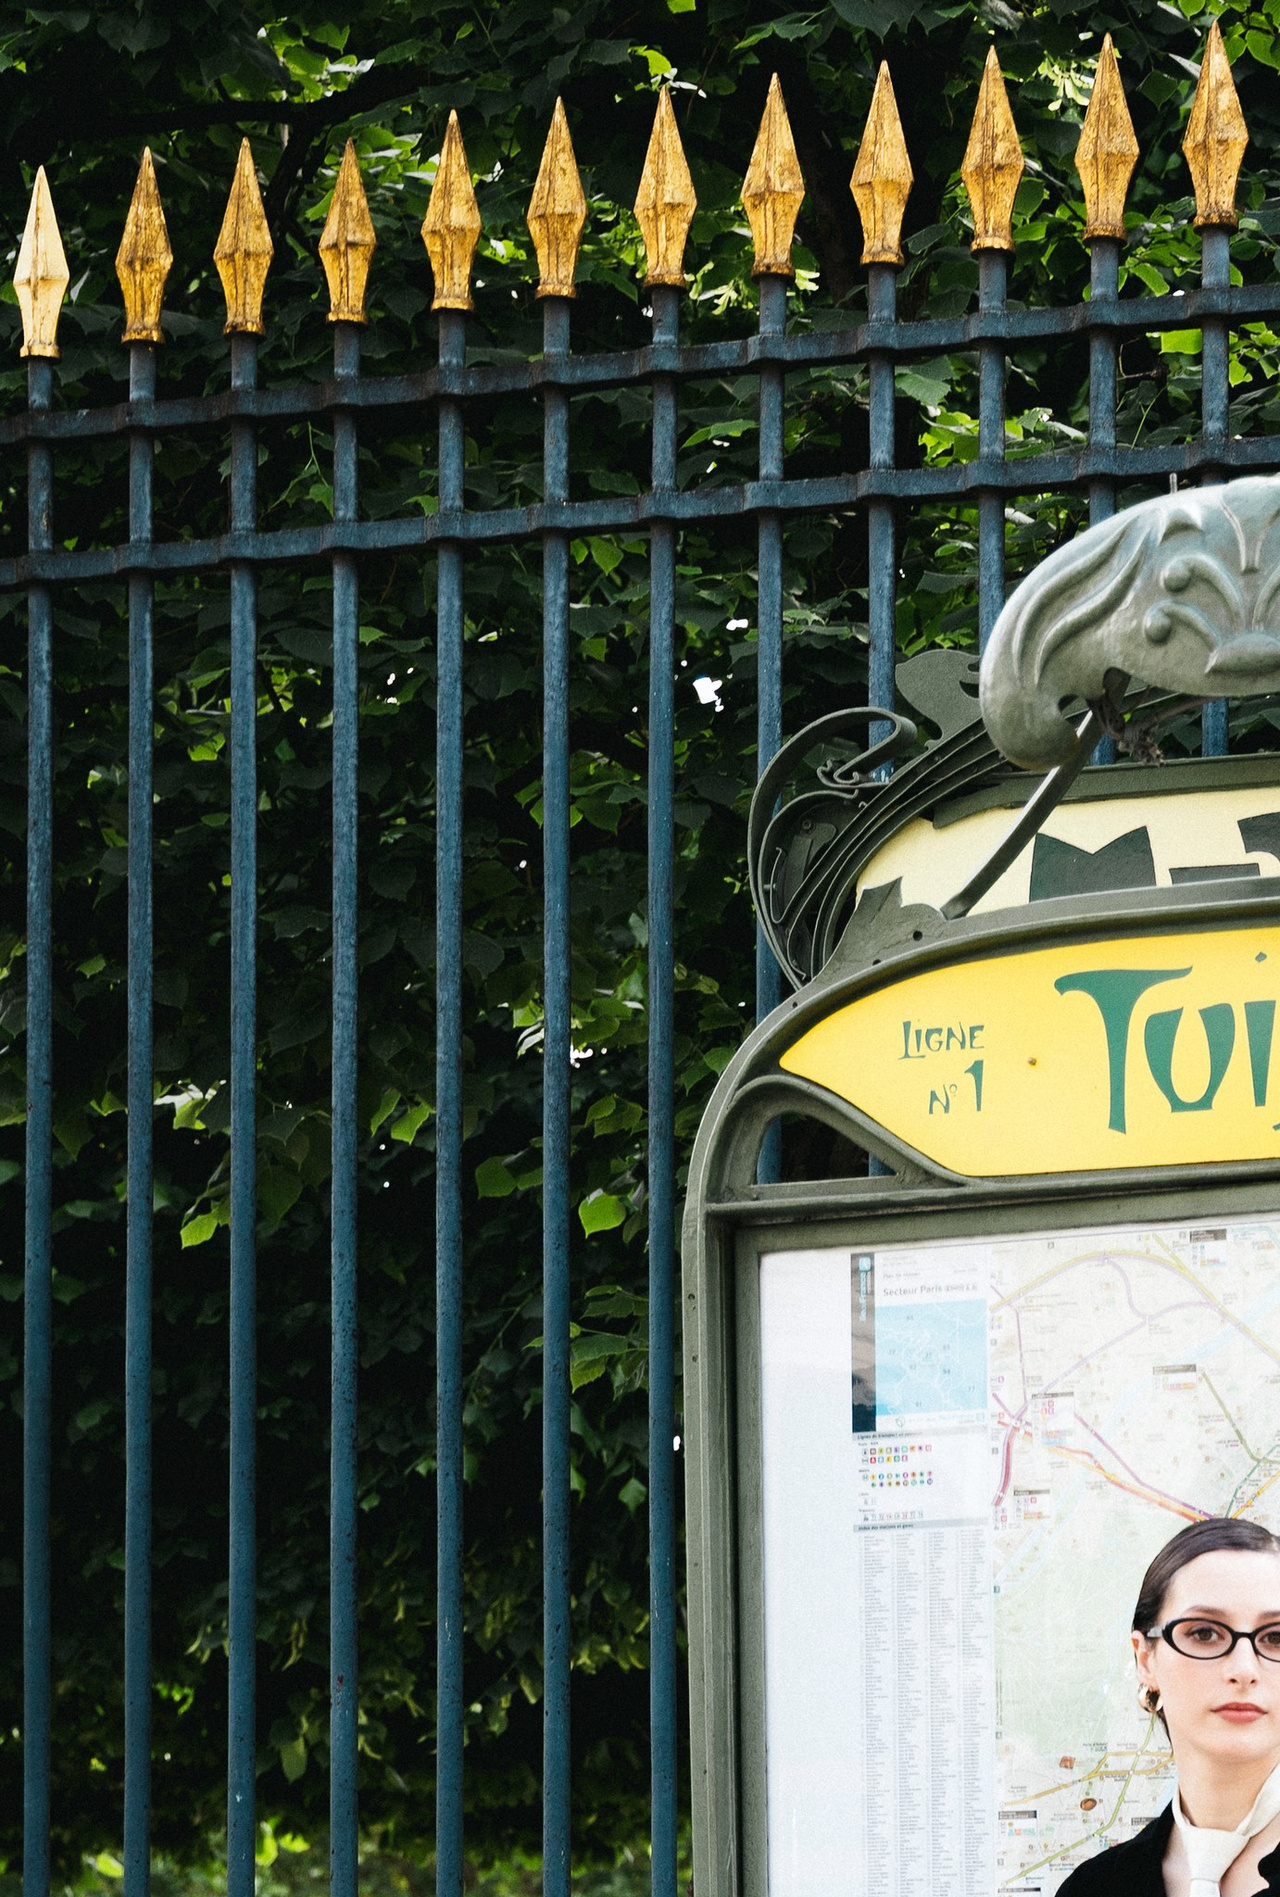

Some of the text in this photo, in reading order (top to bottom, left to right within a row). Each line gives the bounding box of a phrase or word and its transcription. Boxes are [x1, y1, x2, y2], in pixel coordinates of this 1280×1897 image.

[898, 1020, 985, 1061] LIGNE
[883, 1287, 917, 1297] Secteur
[919, 1284, 943, 1294] Paris
